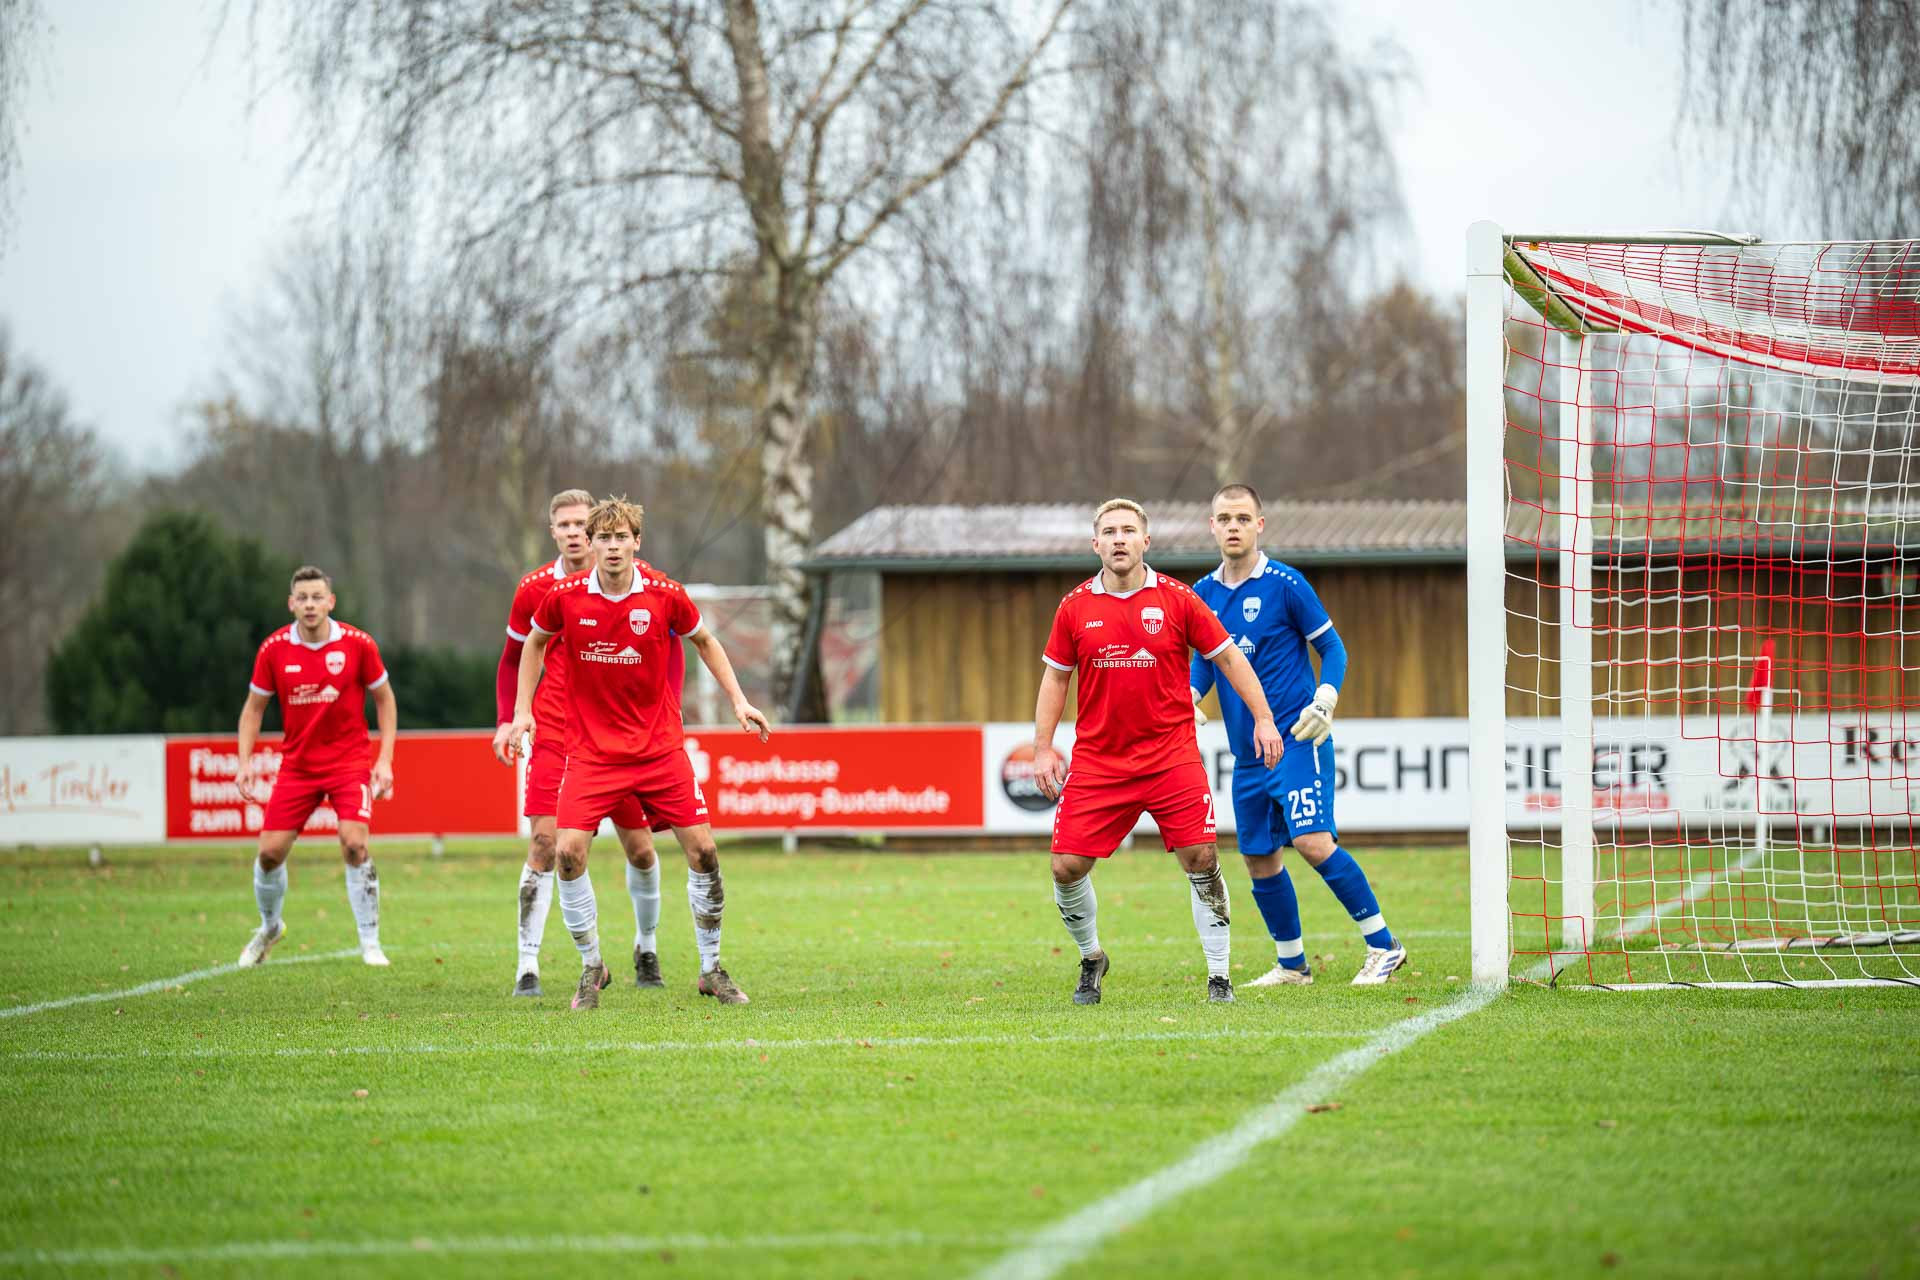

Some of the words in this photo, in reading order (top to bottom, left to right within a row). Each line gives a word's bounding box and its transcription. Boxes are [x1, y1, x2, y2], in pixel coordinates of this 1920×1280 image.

[579, 618, 597, 626] JAKO
[1085, 620, 1103, 629] JAKO
[580, 653, 640, 664] LÜBBERSTEDT
[1093, 660, 1155, 668] LÜBBERSTEDT
[718, 756, 840, 787] Sparkasse
[717, 786, 951, 820] Harburg-Buxtehude
[1288, 787, 1317, 820] 25
[189, 809, 242, 832] zum
[1296, 818, 1313, 828] JAKO
